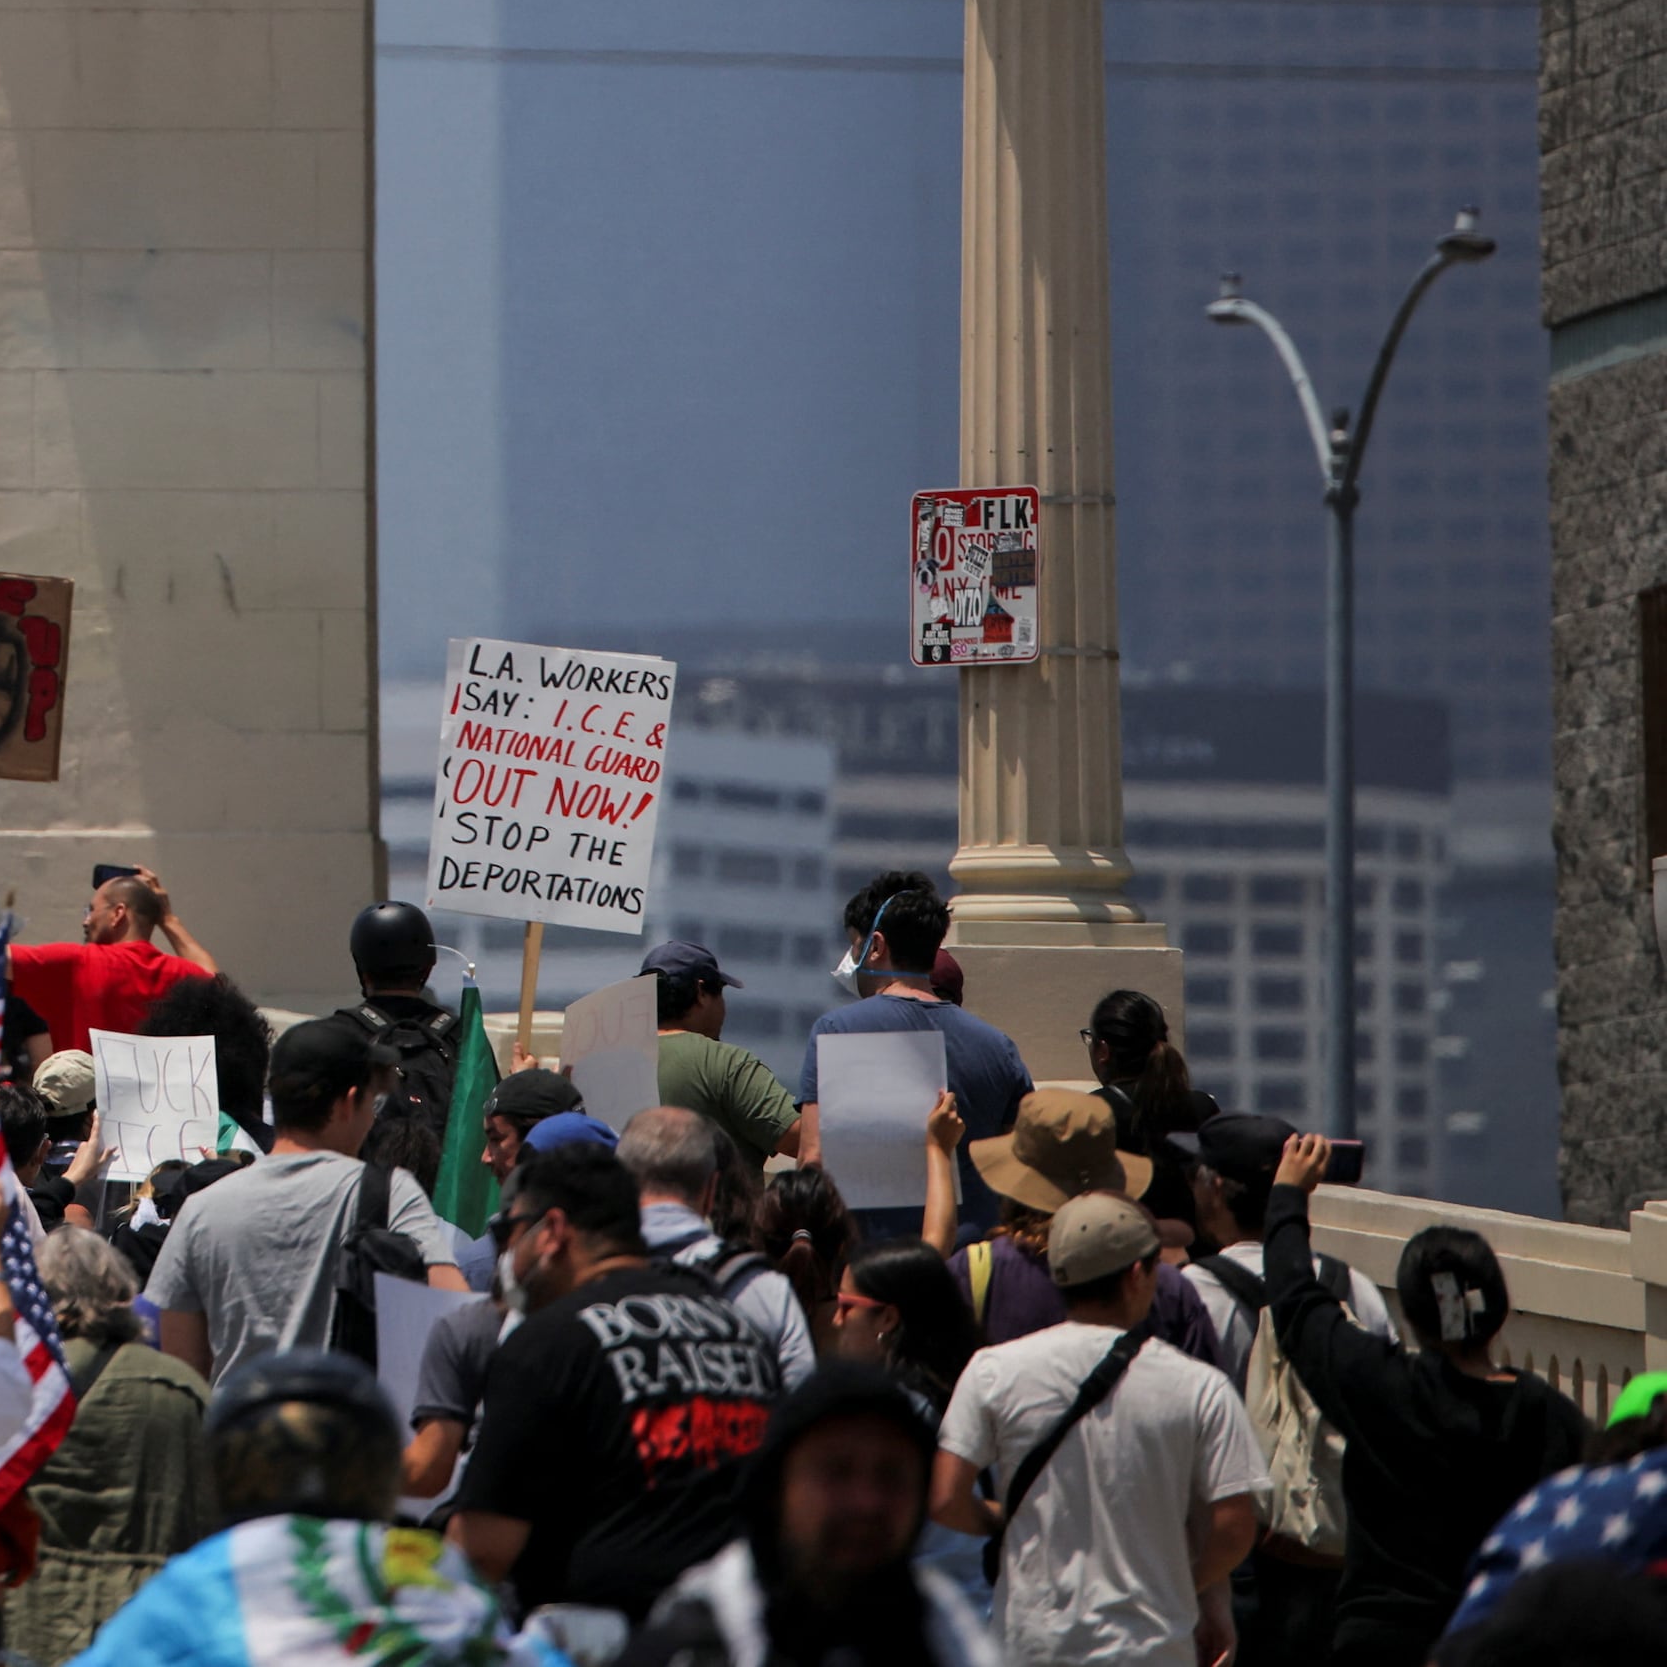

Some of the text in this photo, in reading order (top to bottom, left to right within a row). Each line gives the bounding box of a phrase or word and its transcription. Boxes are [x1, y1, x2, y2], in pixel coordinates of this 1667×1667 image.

[983, 498, 1029, 530] FLK
[468, 644, 671, 700] L.A. WORKERS
[462, 682, 666, 749] SAY: I.C.E. &
[456, 720, 661, 784] NATIONAL GUARD
[452, 758, 654, 830] OUT NOW!
[451, 811, 628, 866] STOP THE
[438, 855, 645, 915] DEPORTATIONS
[98, 1037, 213, 1117] FUCK
